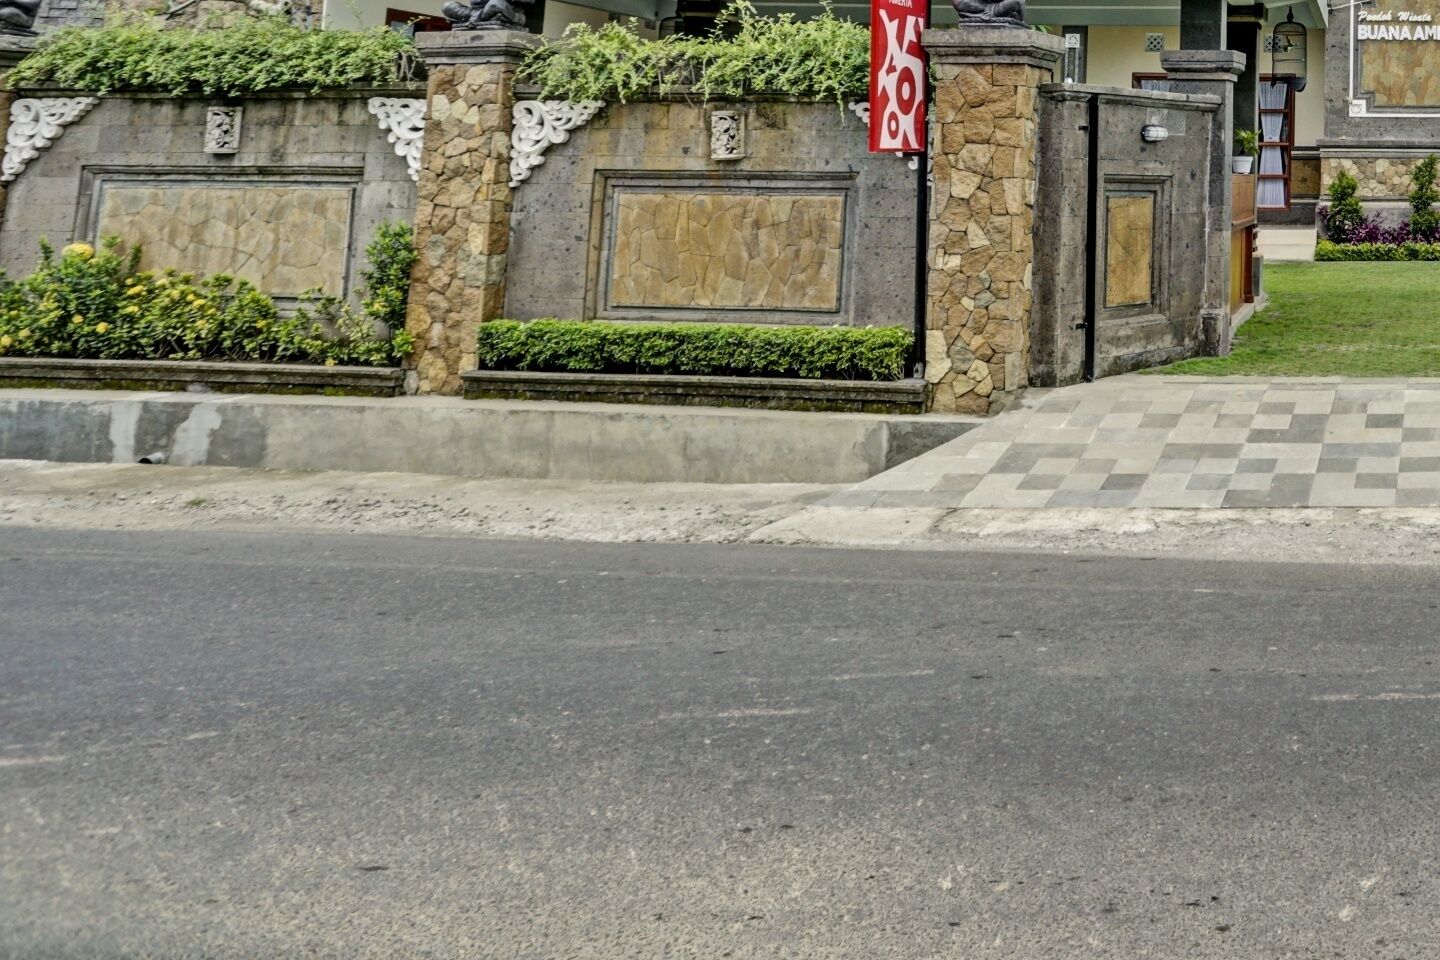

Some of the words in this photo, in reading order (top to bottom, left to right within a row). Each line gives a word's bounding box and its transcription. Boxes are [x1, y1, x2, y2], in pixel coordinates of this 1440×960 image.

[1357, 10, 1392, 22] Pondok
[1398, 11, 1432, 22] Wisata
[1357, 25, 1412, 40] BUANA
